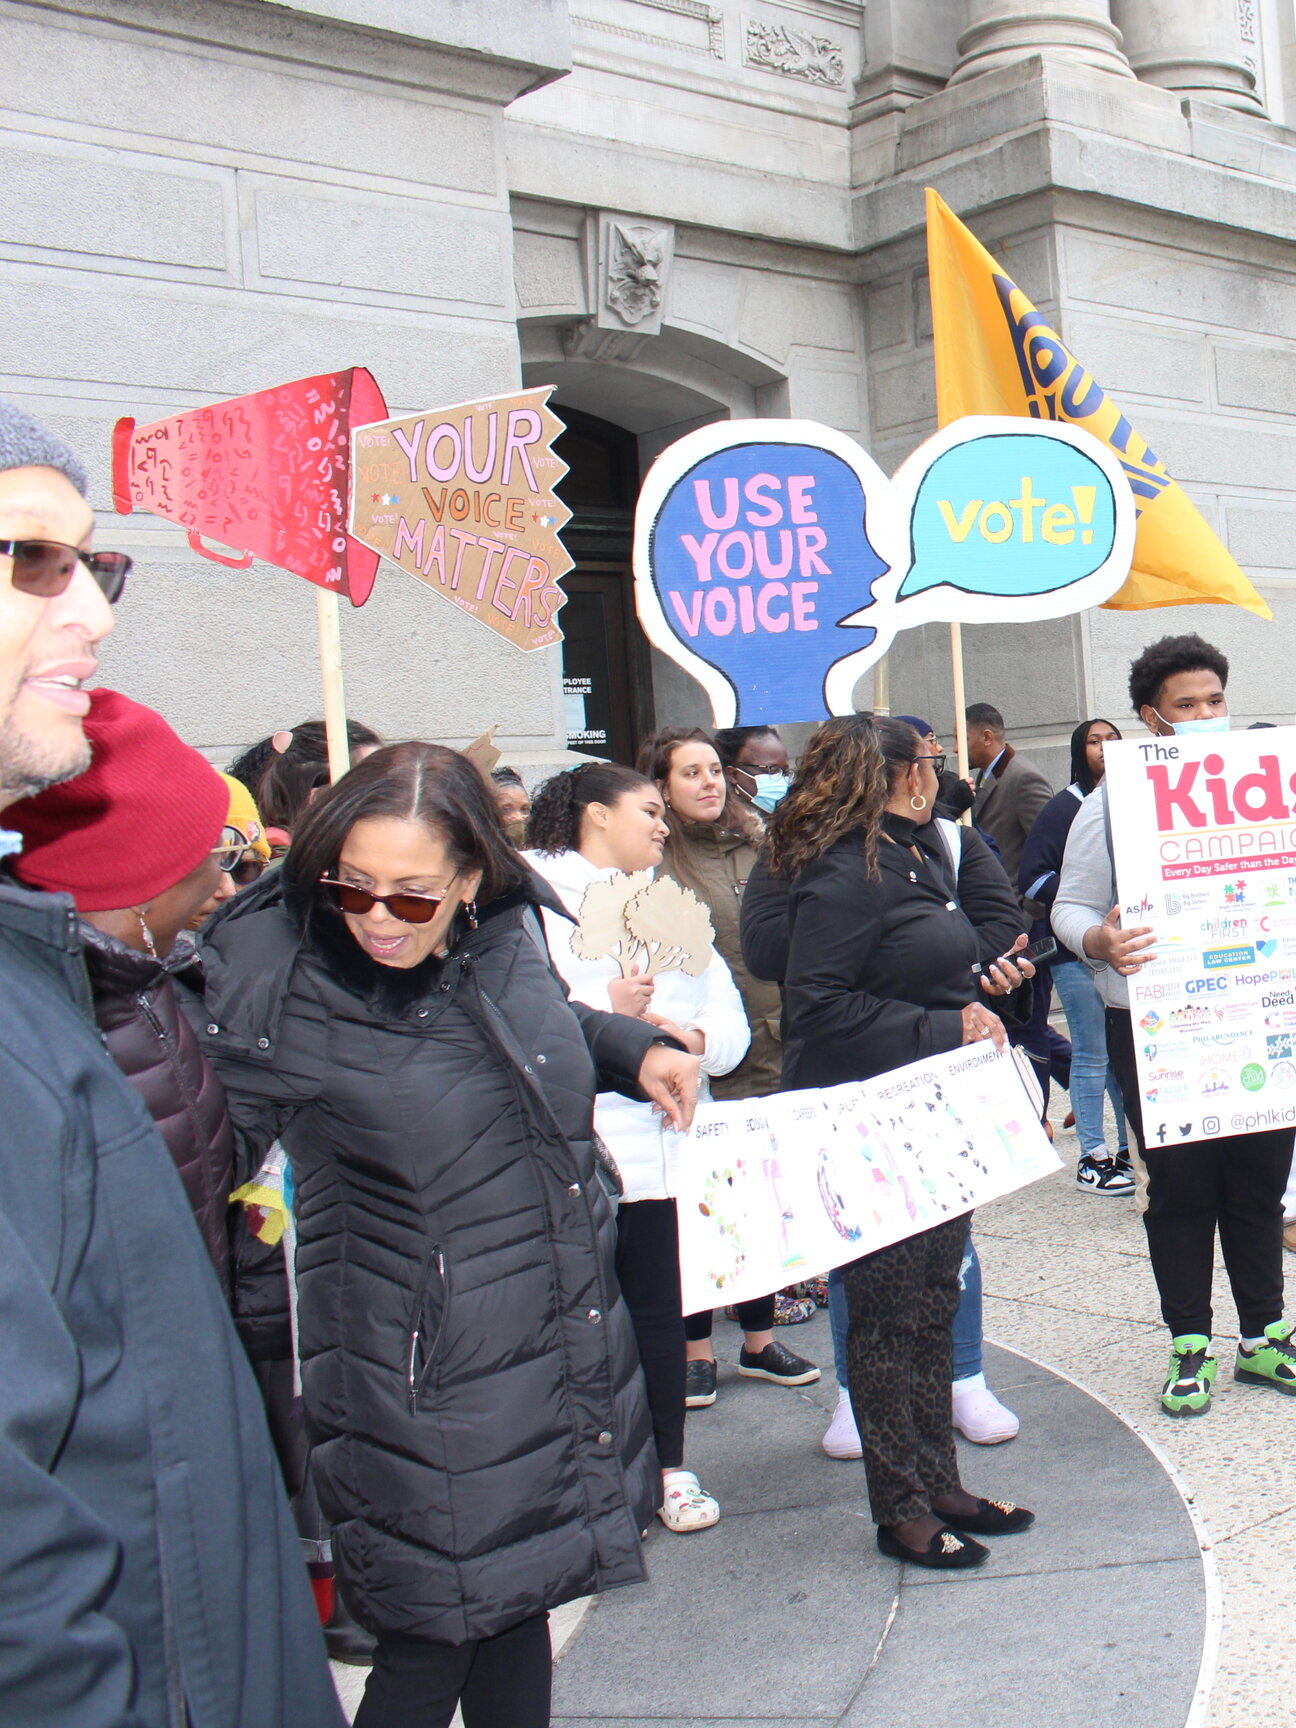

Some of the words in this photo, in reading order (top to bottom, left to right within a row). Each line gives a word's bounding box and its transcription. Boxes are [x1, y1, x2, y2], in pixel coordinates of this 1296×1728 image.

[390, 408, 544, 494] YOUR
[421, 487, 526, 533] VOICE
[693, 473, 818, 531] USE
[937, 477, 1098, 545] vote!
[681, 527, 832, 581] YOUR
[669, 581, 819, 637] VOICE
[563, 677, 592, 686] PLOYEE
[563, 686, 592, 694] TRANCE
[1139, 744, 1179, 762] The
[1164, 865, 1192, 878] Every
[1193, 862, 1212, 875] Day
[1213, 860, 1239, 872] Safer
[1240, 857, 1263, 870] than
[1264, 856, 1280, 867] the
[1200, 917, 1247, 931] children
[1211, 926, 1247, 939] FIRST
[1208, 951, 1249, 960] EDUCATION
[1185, 976, 1228, 995] GPEC
[1261, 994, 1295, 1008] Deed
[1148, 1069, 1184, 1081] Sunrise
[696, 1122, 729, 1139] SAFETY
[877, 1071, 939, 1101] RECREATION
